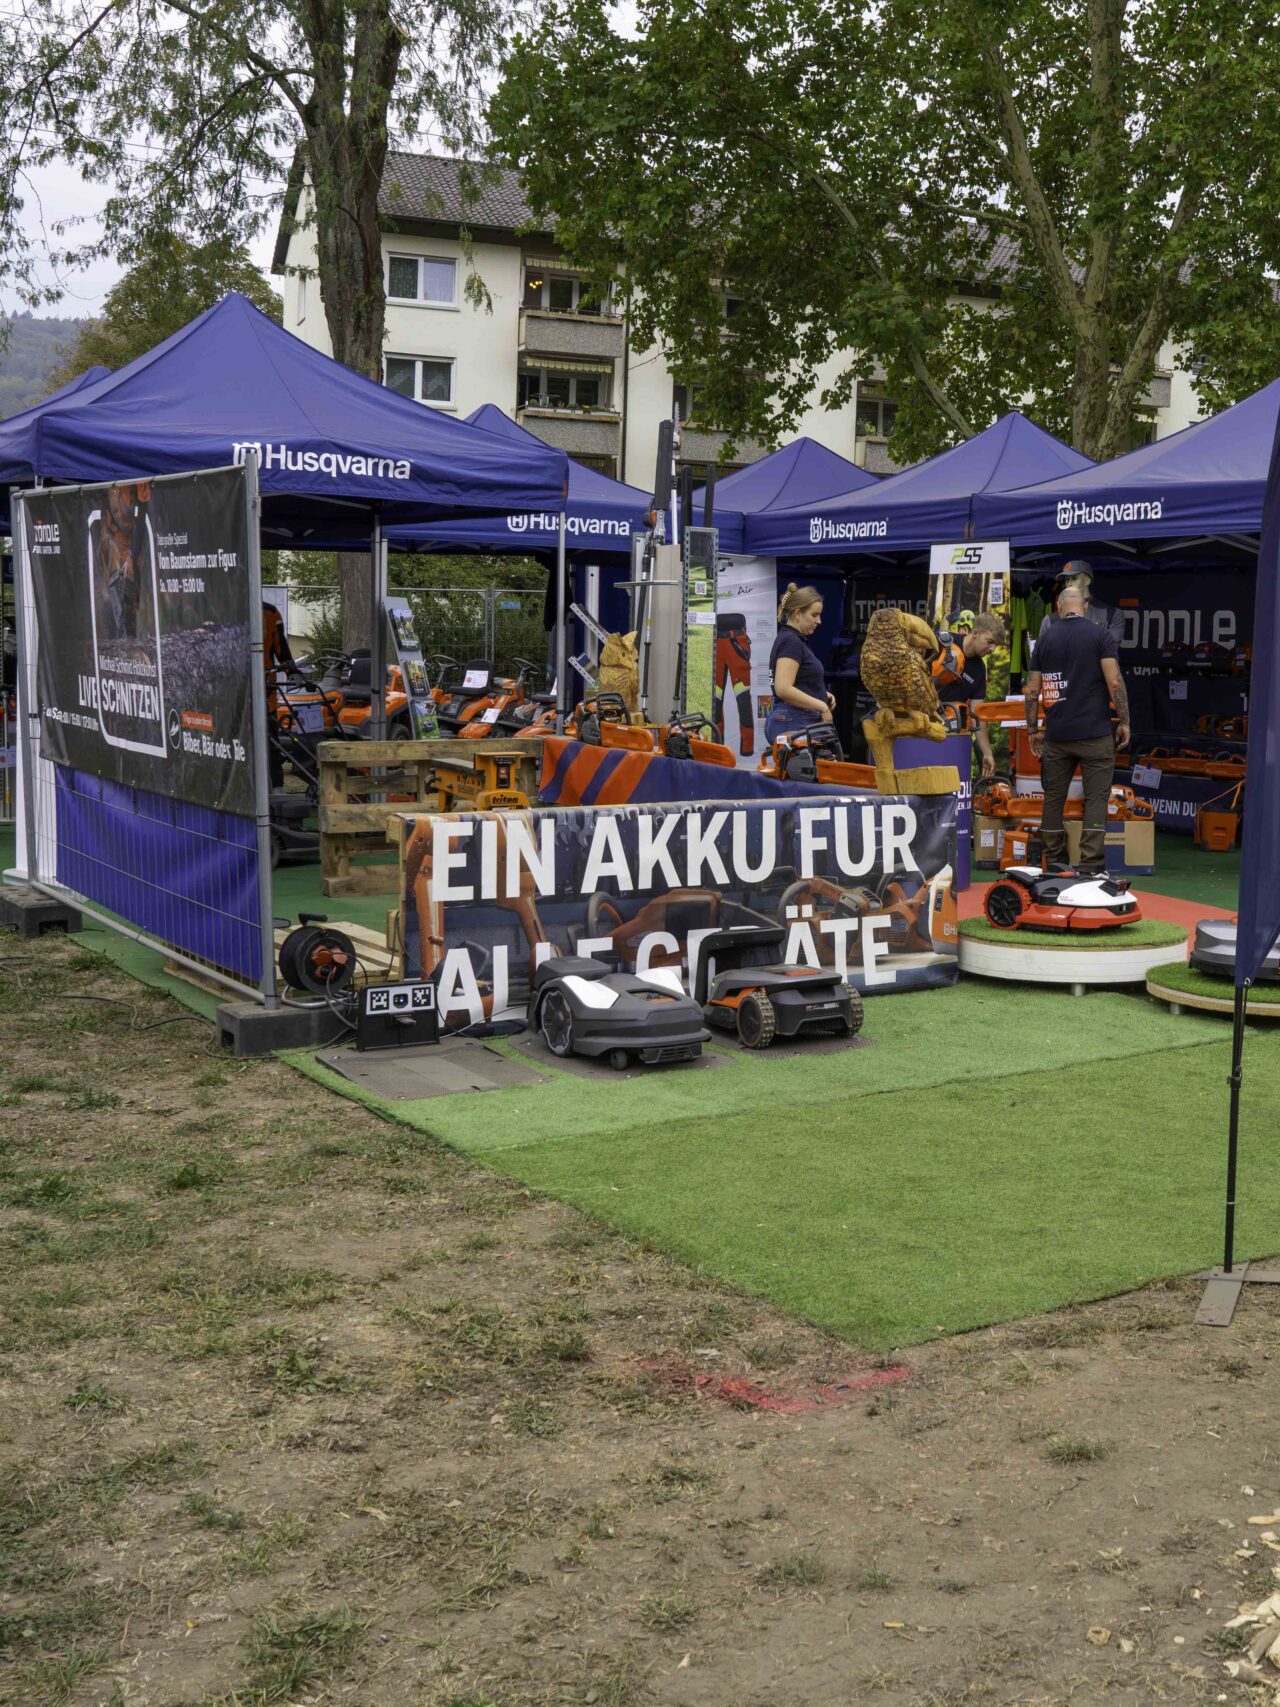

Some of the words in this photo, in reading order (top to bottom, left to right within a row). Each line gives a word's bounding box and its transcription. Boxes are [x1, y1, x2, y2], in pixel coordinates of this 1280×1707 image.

[265, 443, 411, 480] Husqvarna
[1074, 501, 1162, 526] Husqvarna
[822, 520, 887, 541] Husqvarna
[158, 552, 170, 570] Vom
[170, 551, 207, 569] Baumstamm
[207, 554, 218, 568] zur
[218, 548, 237, 572] Figur
[1042, 672, 1062, 681] FORST
[1043, 680, 1068, 690] GARTEN
[78, 675, 98, 709] LIVE
[101, 678, 161, 721] SCHNITZEN
[1044, 690, 1060, 699] LAND
[183, 731, 202, 757] Biber,
[202, 735, 214, 757] Bär
[215, 738, 232, 760] oder
[1149, 798, 1180, 815] WENN
[1182, 802, 1197, 817] DU
[432, 818, 556, 902] EIN
[580, 809, 778, 895] AKKU
[799, 796, 922, 879] FÜR
